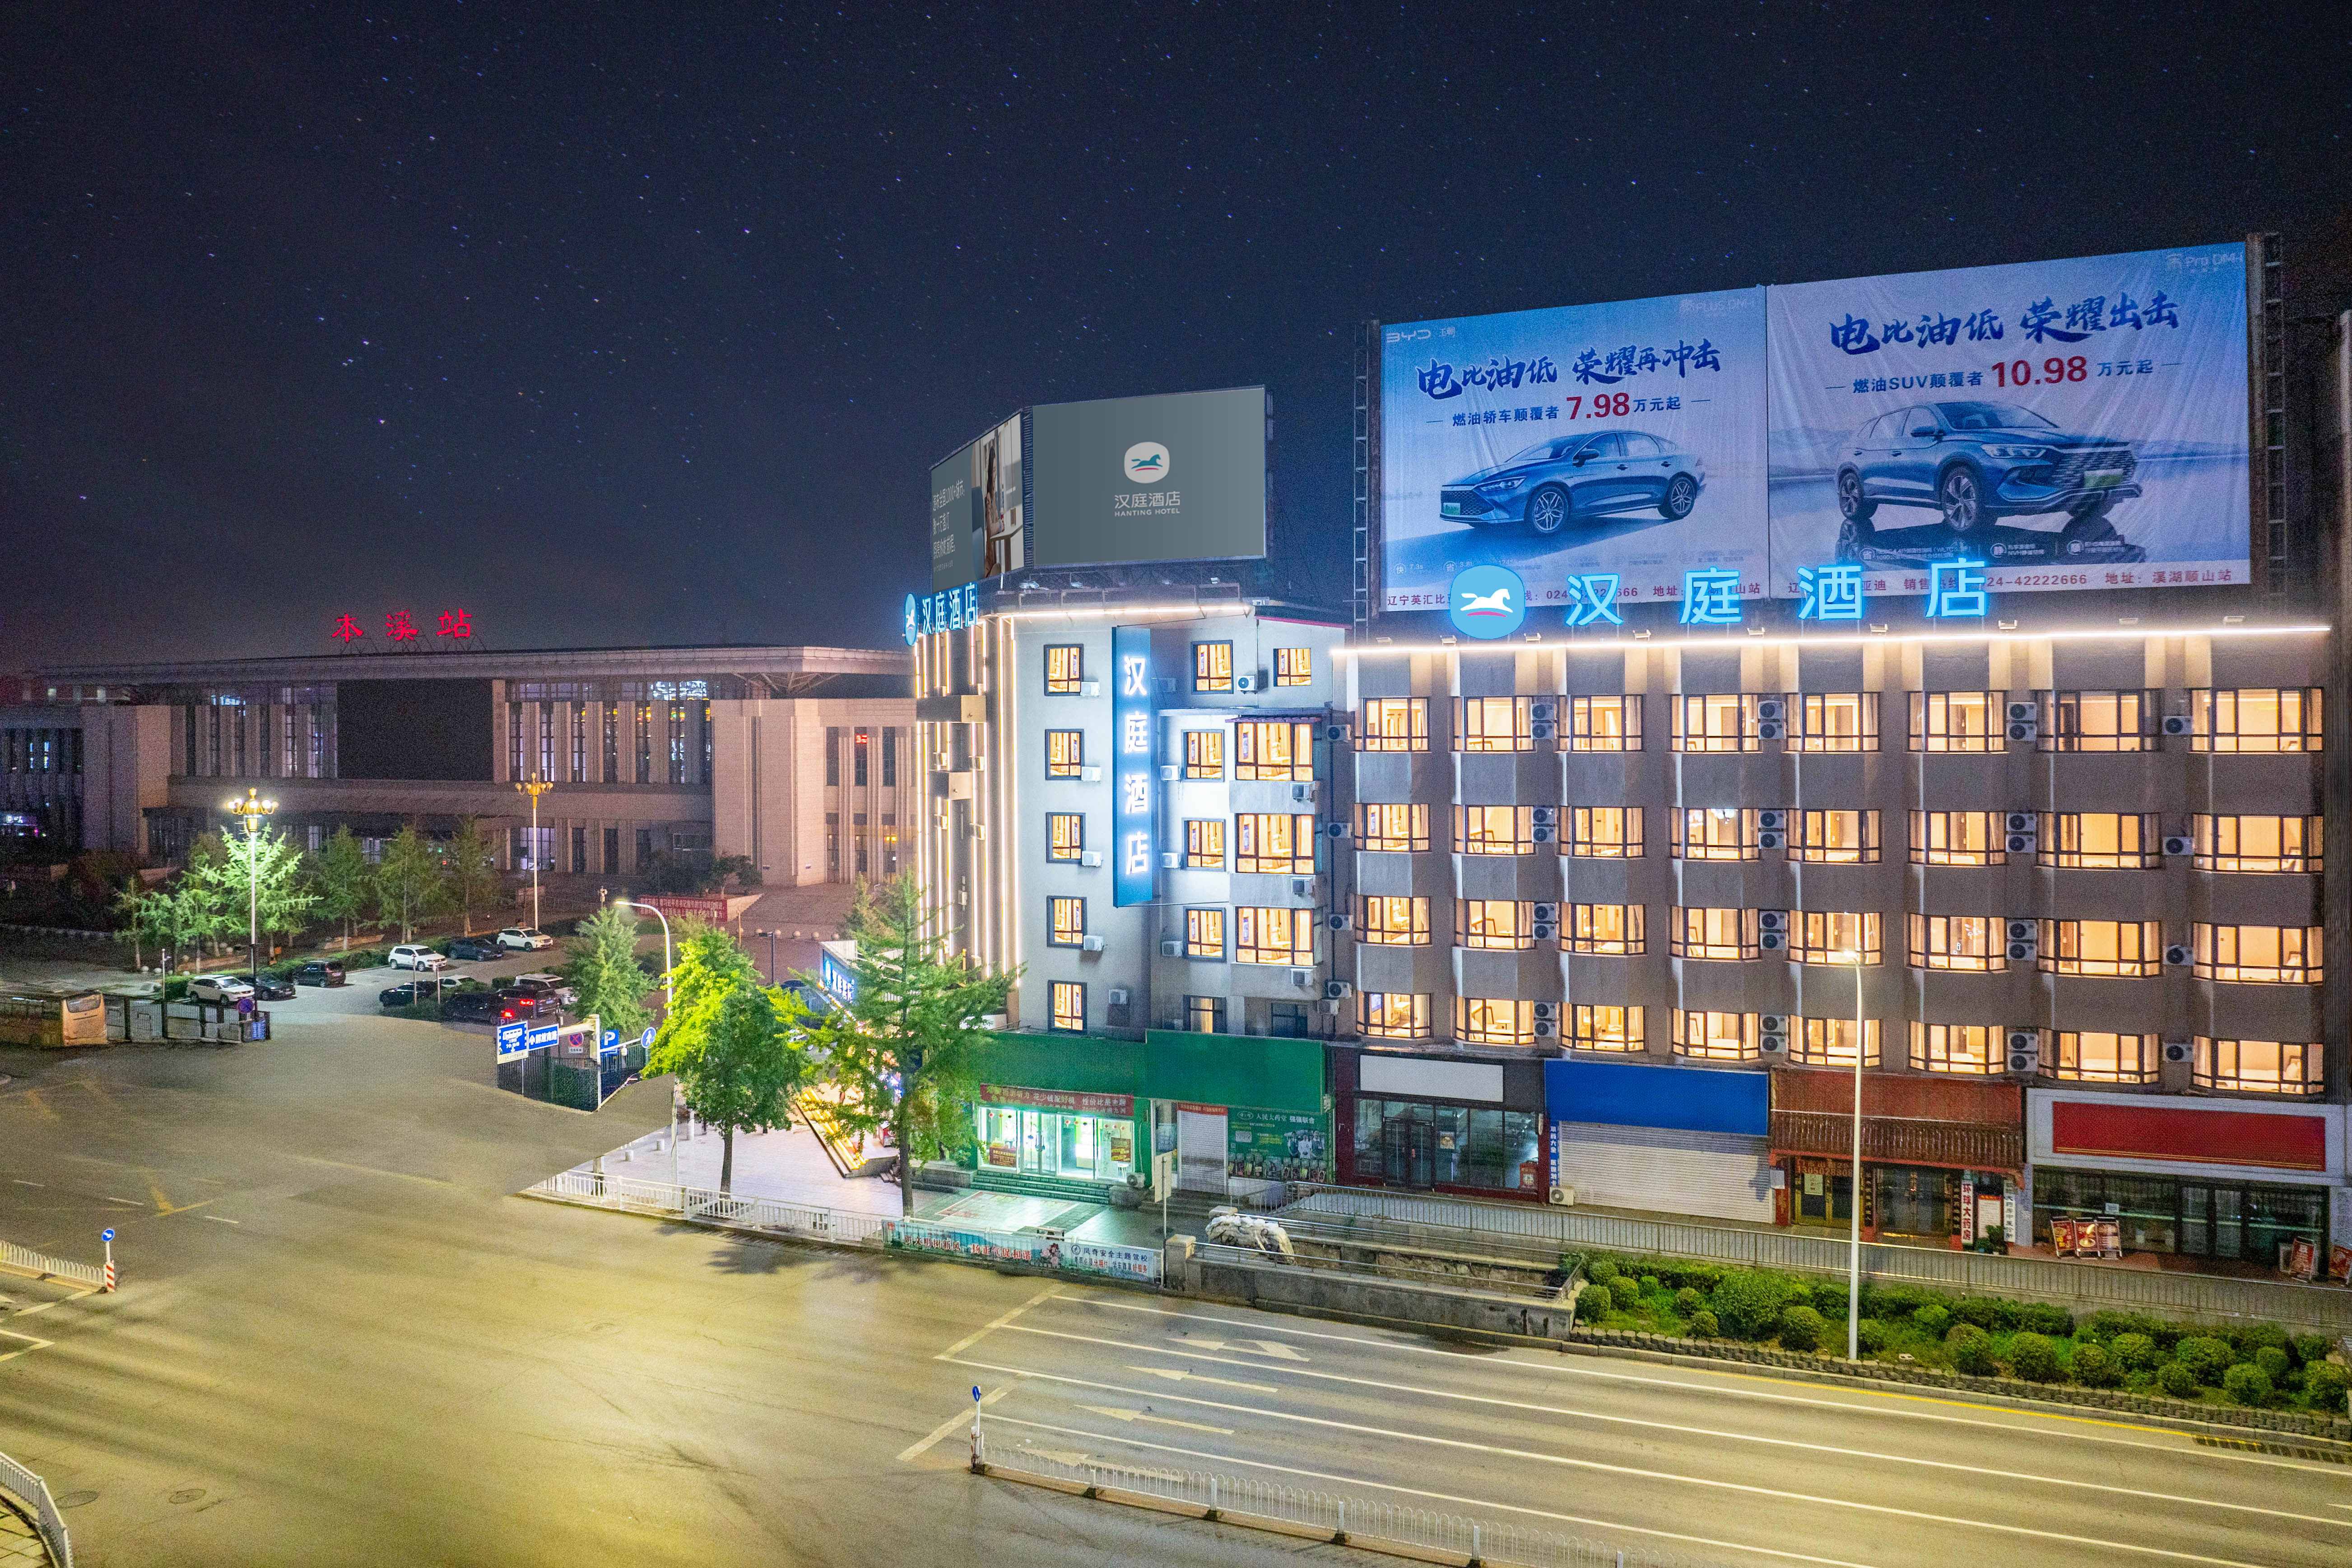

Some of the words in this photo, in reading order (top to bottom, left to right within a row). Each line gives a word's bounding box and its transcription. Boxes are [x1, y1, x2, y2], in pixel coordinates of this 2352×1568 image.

[1386, 329, 1431, 343] BYD
[1830, 307, 2004, 355] 电比油低
[2021, 289, 2180, 344] 荣耀出击
[1417, 354, 1557, 400] 电比油低
[1572, 337, 1721, 384] 荣耀再冲击
[1853, 369, 1983, 394] 燃油SUV颠覆者
[1990, 356, 2088, 389] 10.98
[2097, 359, 2153, 377] 万元起
[1452, 405, 1560, 428] 燃油轿车颠覆者
[1566, 392, 1630, 421] 7.98
[1634, 396, 1681, 414] 万元起
[1115, 491, 1181, 509] 汉庭酒店
[1115, 508, 1152, 517] HANTING
[1155, 506, 1181, 515] HOTEL
[1565, 557, 1987, 627] 汉庭酒店
[1983, 572, 2087, 588] 24-42222666
[922, 582, 977, 635] 汉庭酒店
[1387, 595, 1450, 606] 辽宁英汇比
[332, 608, 472, 642] 本溪站
[1125, 656, 1148, 875] 汉庭酒店
[604, 1032, 616, 1046] P
[971, 1243, 1032, 1261] 扬正气促和谐
